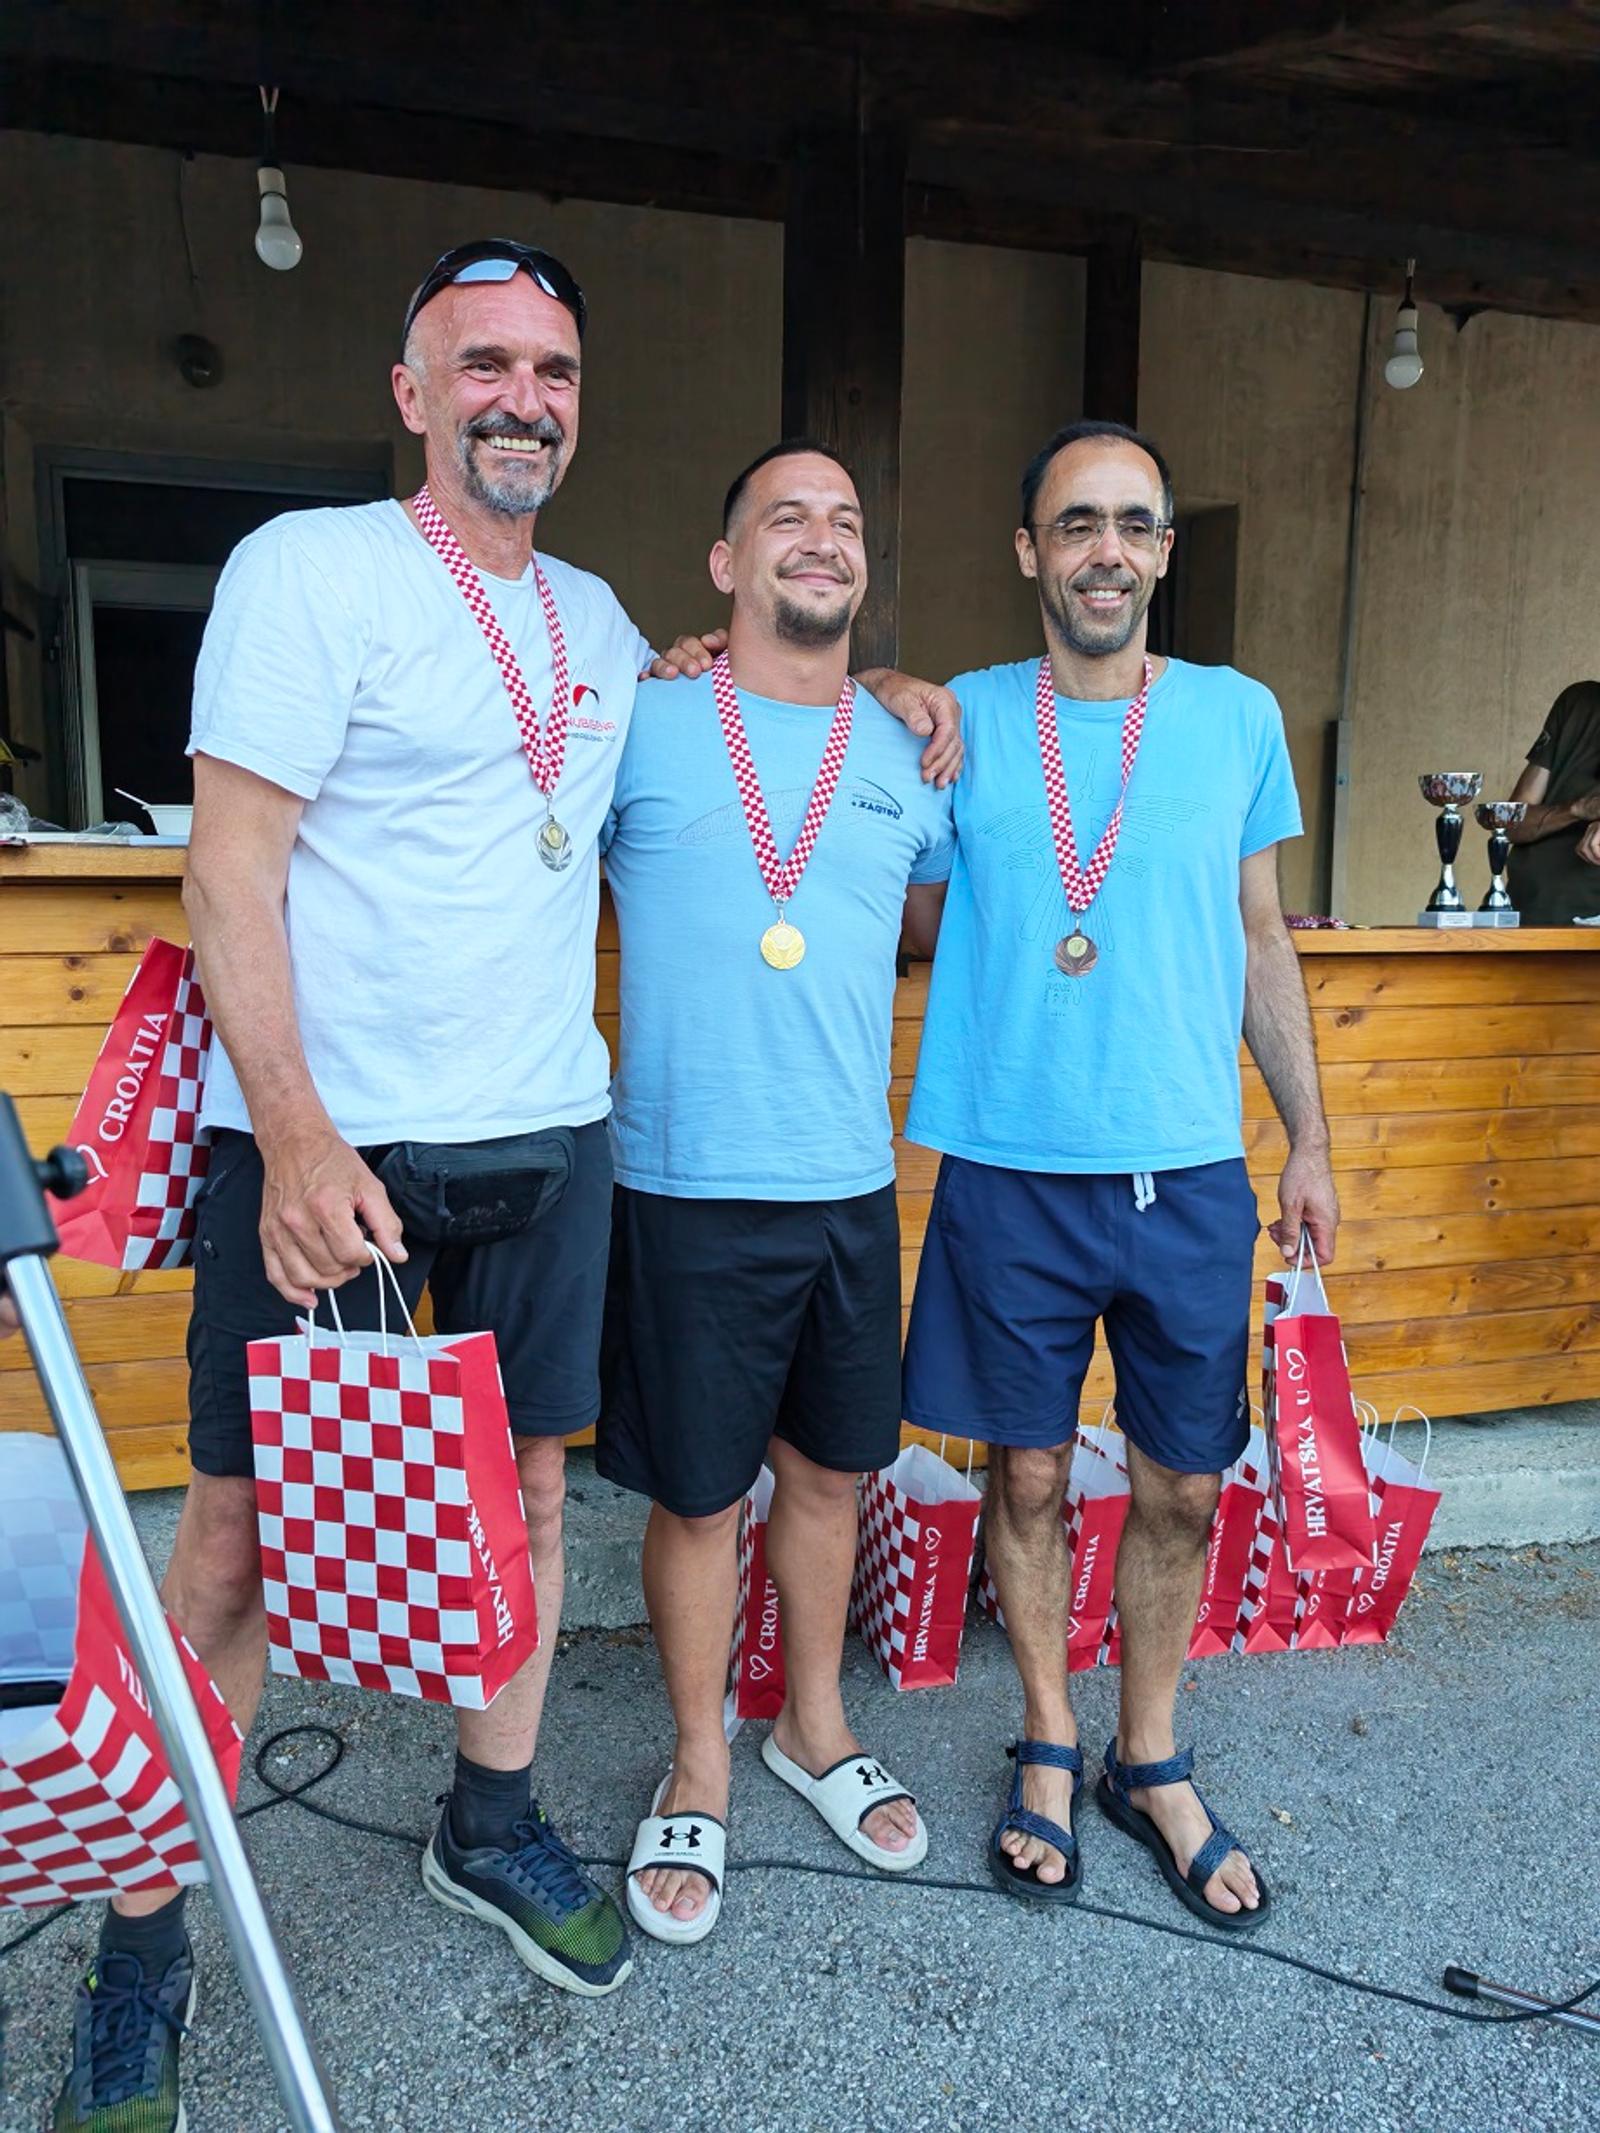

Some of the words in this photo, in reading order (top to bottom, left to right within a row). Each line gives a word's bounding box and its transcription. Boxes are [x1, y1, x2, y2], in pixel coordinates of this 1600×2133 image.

[99, 1012, 168, 1142] CROATIA
[1297, 1415, 1327, 1537] HRVATSKA
[466, 1500, 515, 1648] HRVATSK
[1073, 1534, 1100, 1611] CROATIA
[1371, 1520, 1404, 1592] CROATIA
[912, 1573, 937, 1663] HRVATSKA
